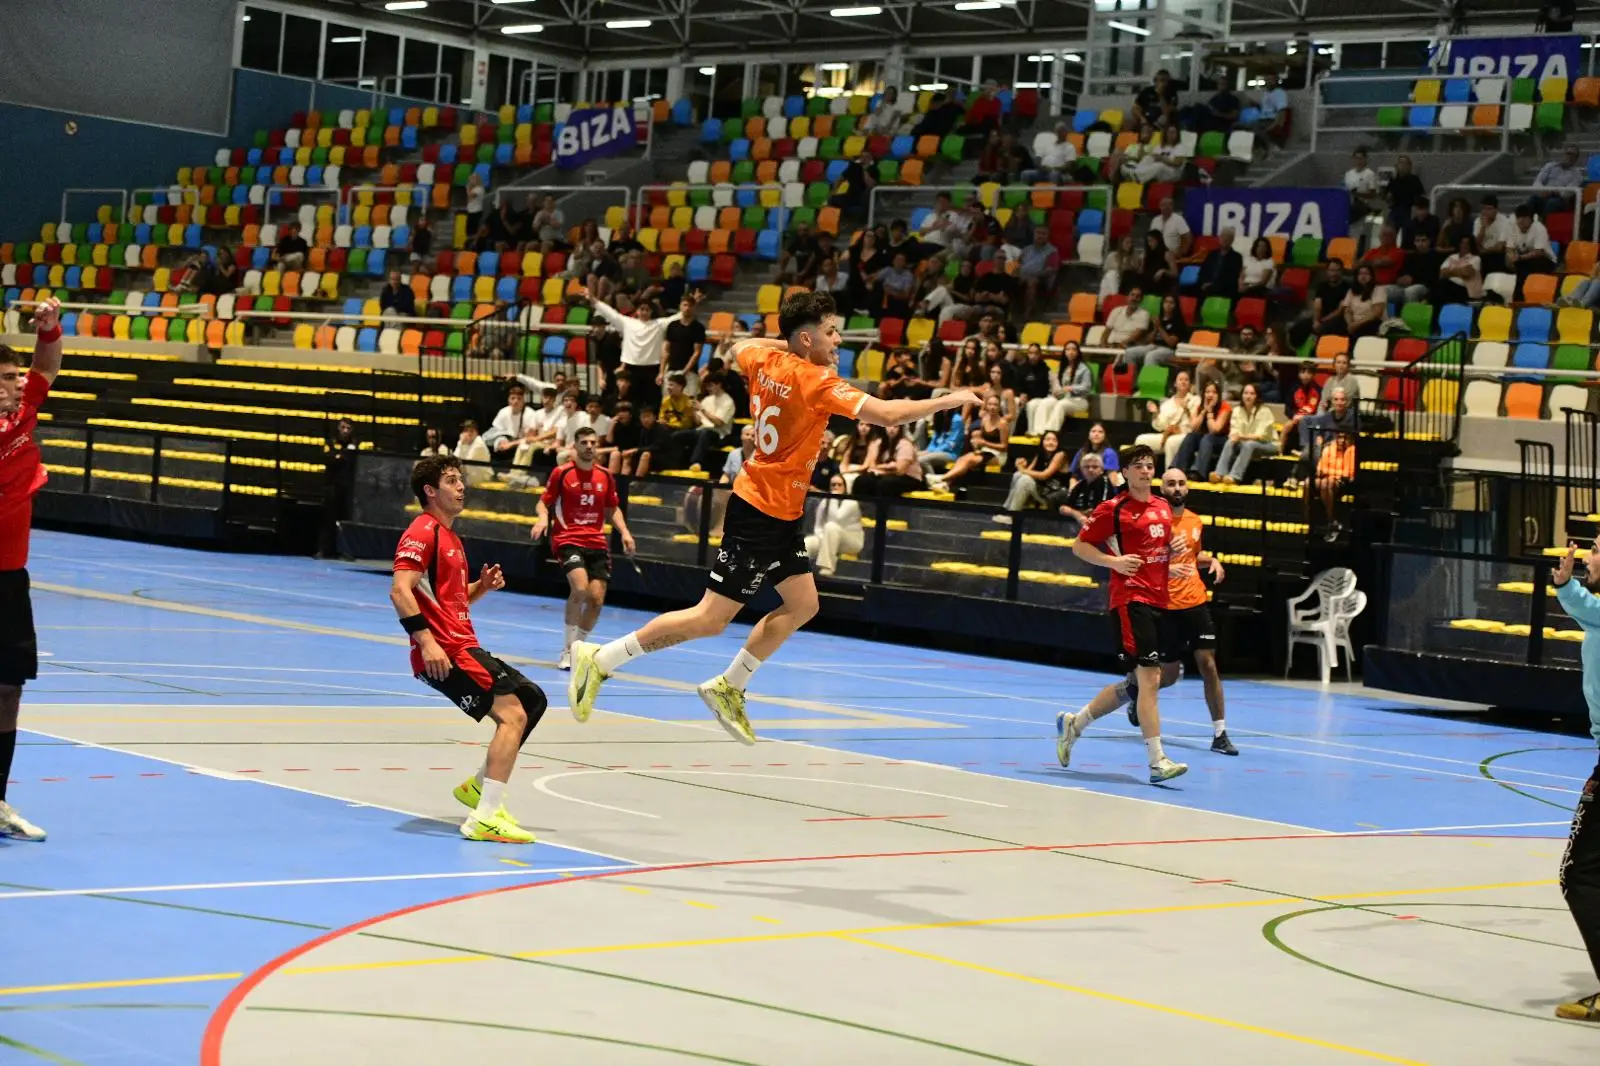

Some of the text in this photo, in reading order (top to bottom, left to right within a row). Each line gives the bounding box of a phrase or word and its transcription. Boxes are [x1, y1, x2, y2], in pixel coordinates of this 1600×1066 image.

[552, 107, 631, 161] BIZA
[580, 494, 595, 506] 24
[1149, 523, 1165, 538] 86
